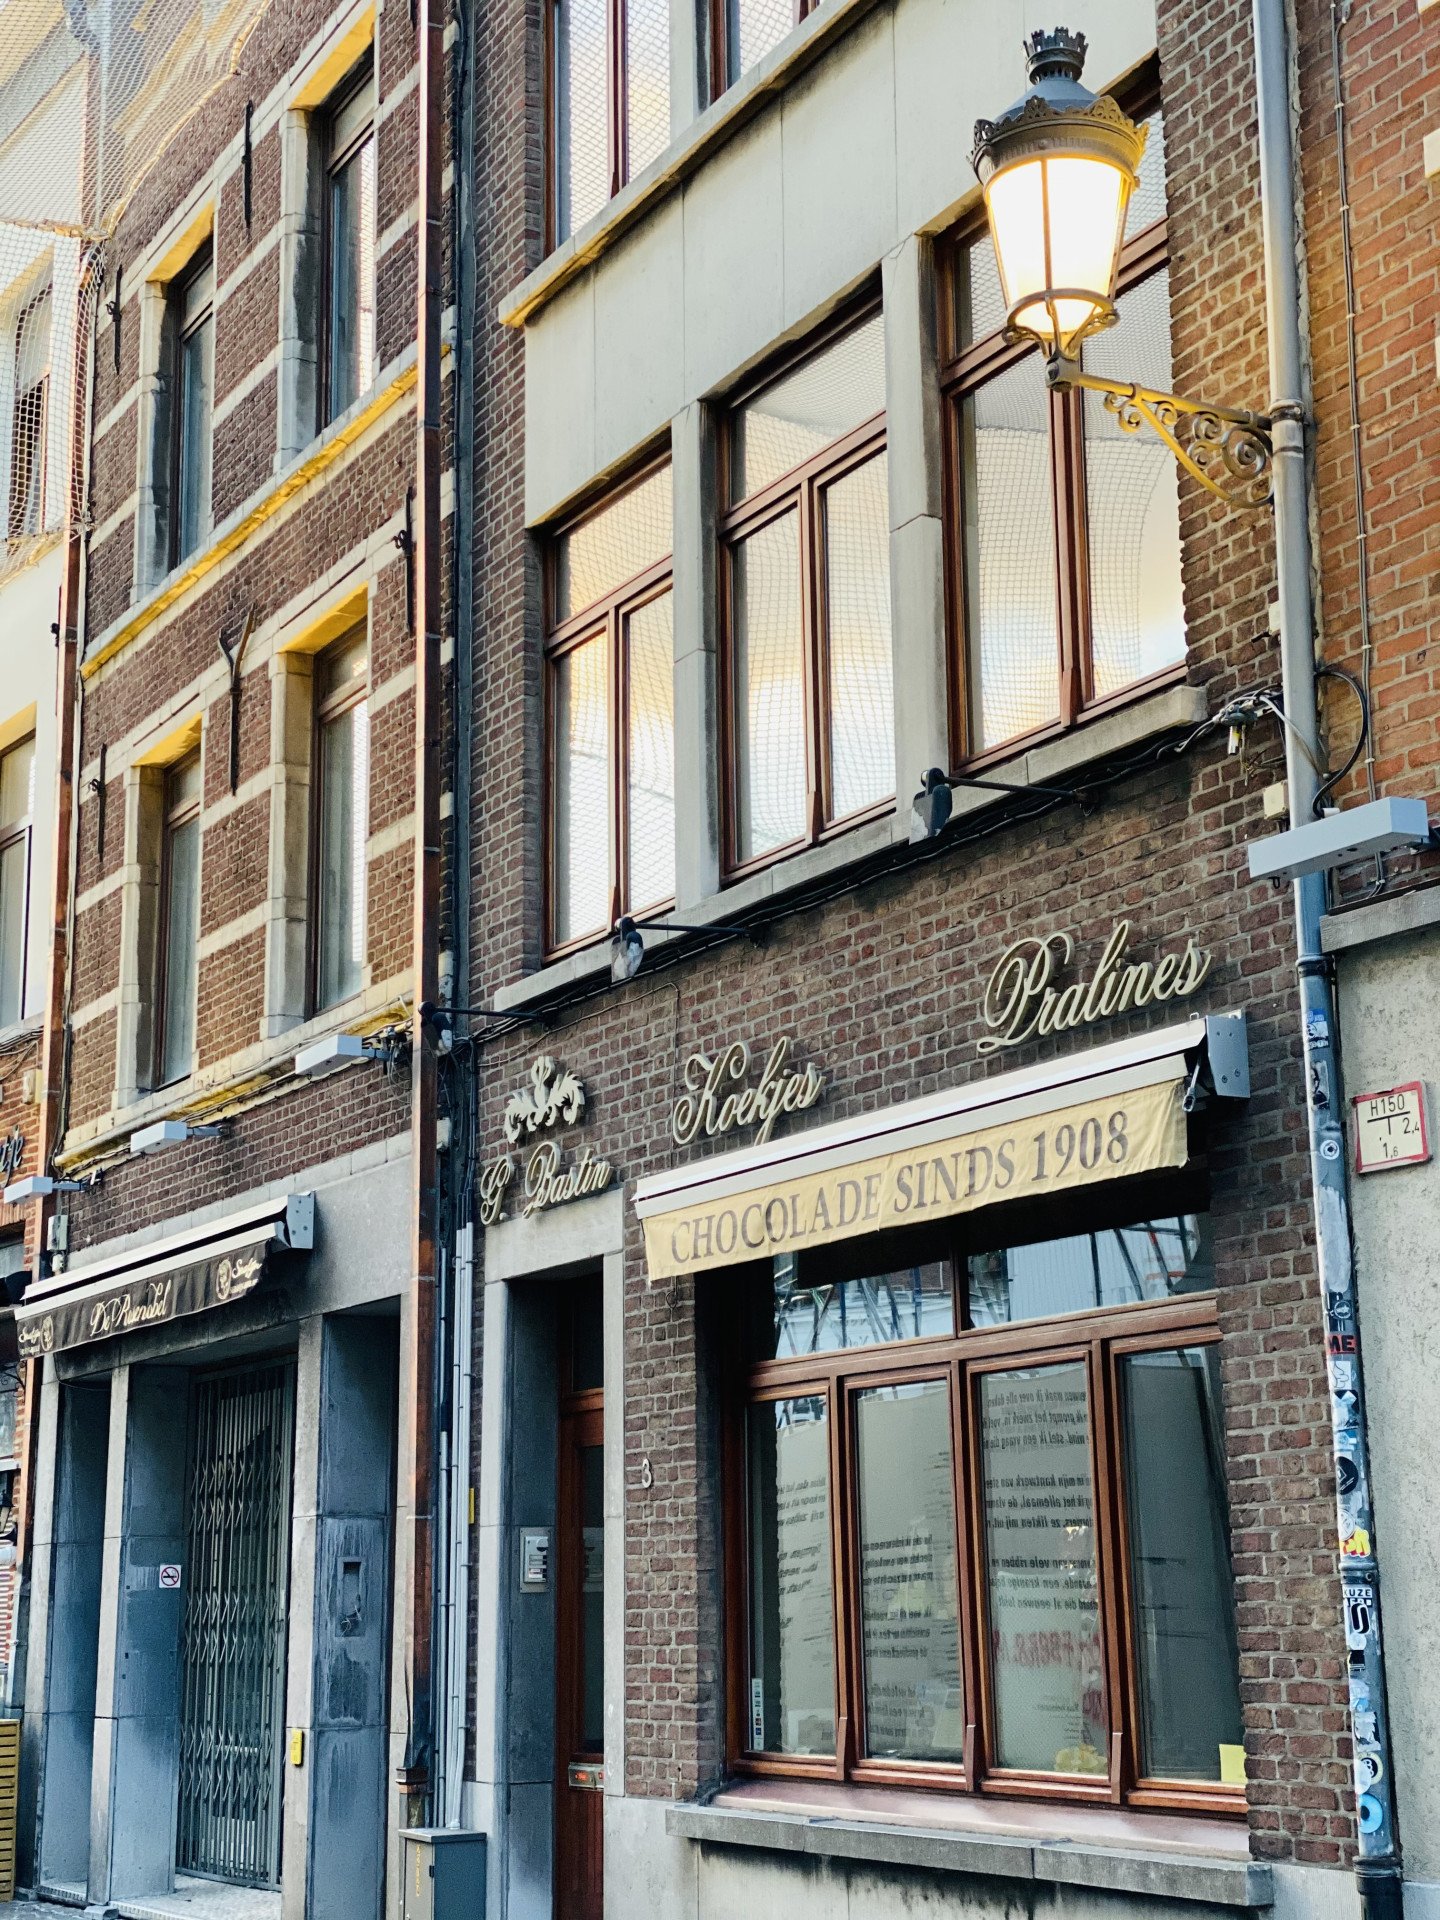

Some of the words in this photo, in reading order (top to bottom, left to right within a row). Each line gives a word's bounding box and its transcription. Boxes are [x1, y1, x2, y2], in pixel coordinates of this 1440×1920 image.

[977, 920, 1212, 1052] Pralines
[673, 1036, 827, 1146] Koekjes
[1370, 1094, 1405, 1116] H150
[522, 1141, 615, 1219] Bastin
[671, 1173, 883, 1264] CHOCOLADE
[894, 1138, 1016, 1214] SINDS
[1033, 1110, 1129, 1182] 1908
[641, 1458, 652, 1489] 3
